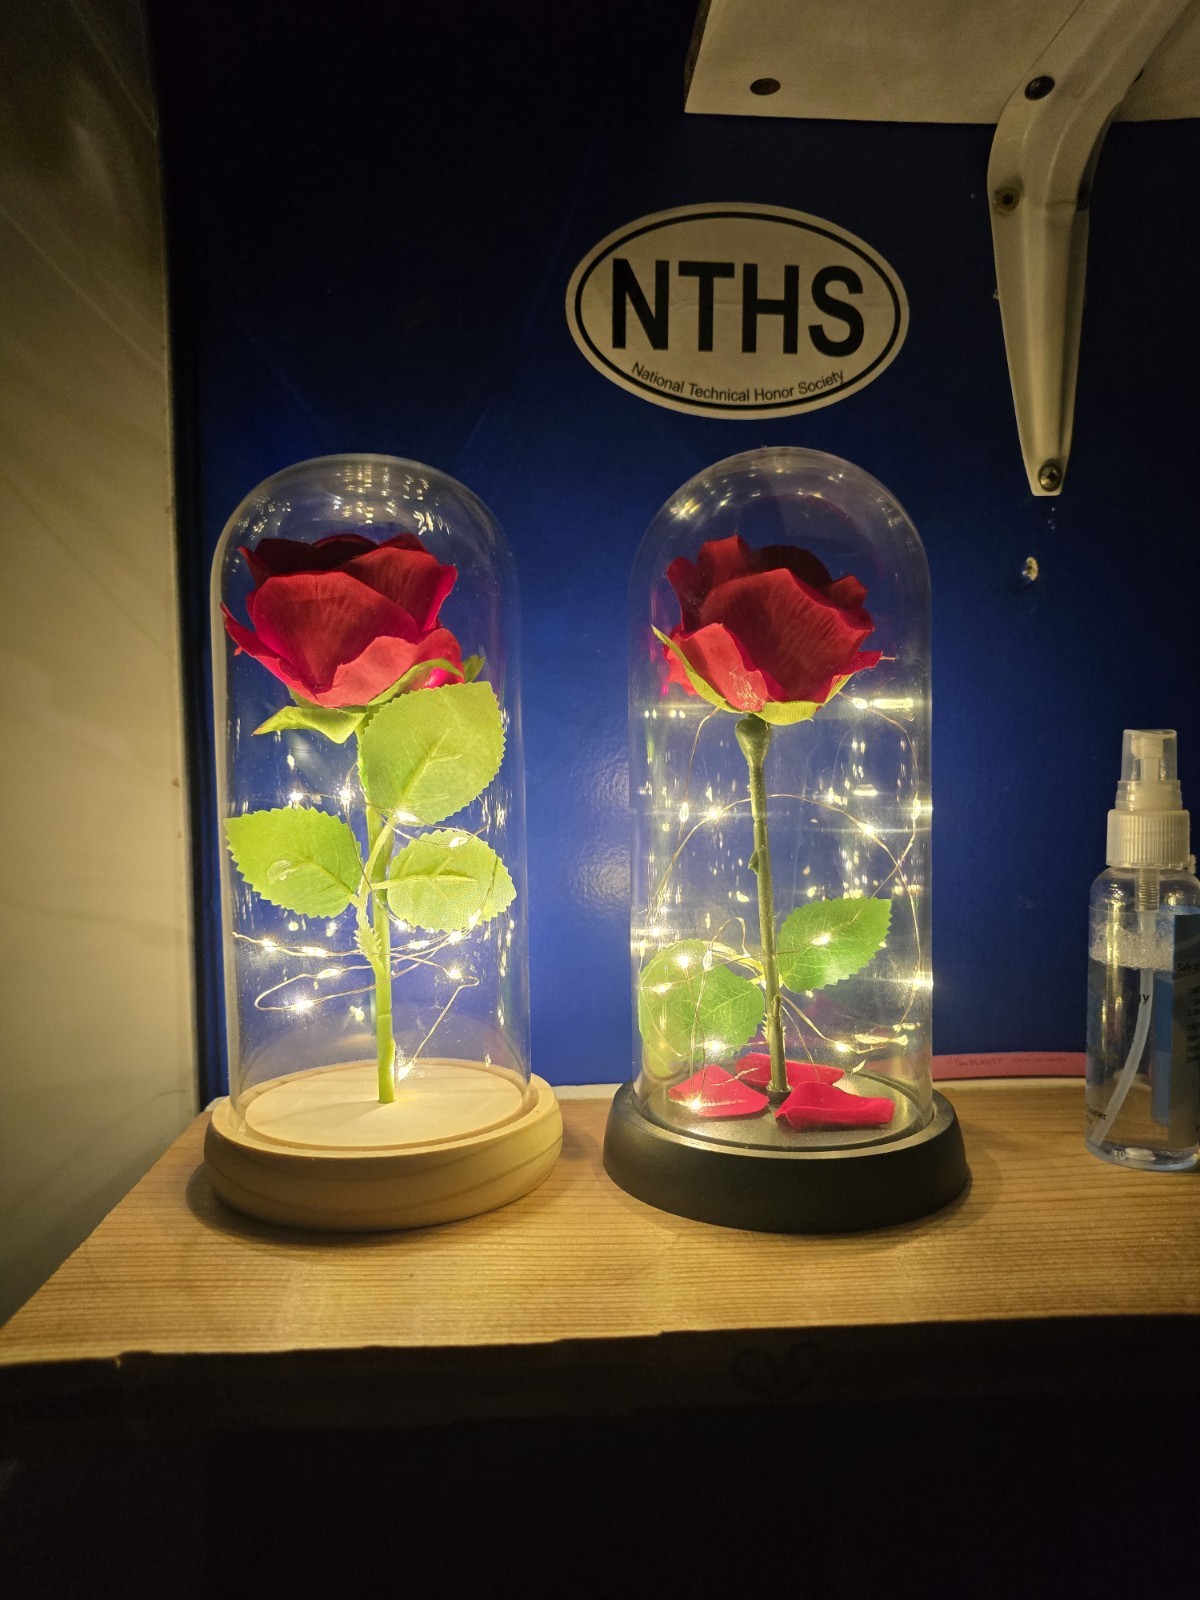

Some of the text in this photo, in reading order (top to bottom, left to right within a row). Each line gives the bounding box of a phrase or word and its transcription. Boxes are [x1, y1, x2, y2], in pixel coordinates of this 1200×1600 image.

[612, 258, 865, 358] NTHS
[631, 361, 844, 402] National Technical Honor Society
